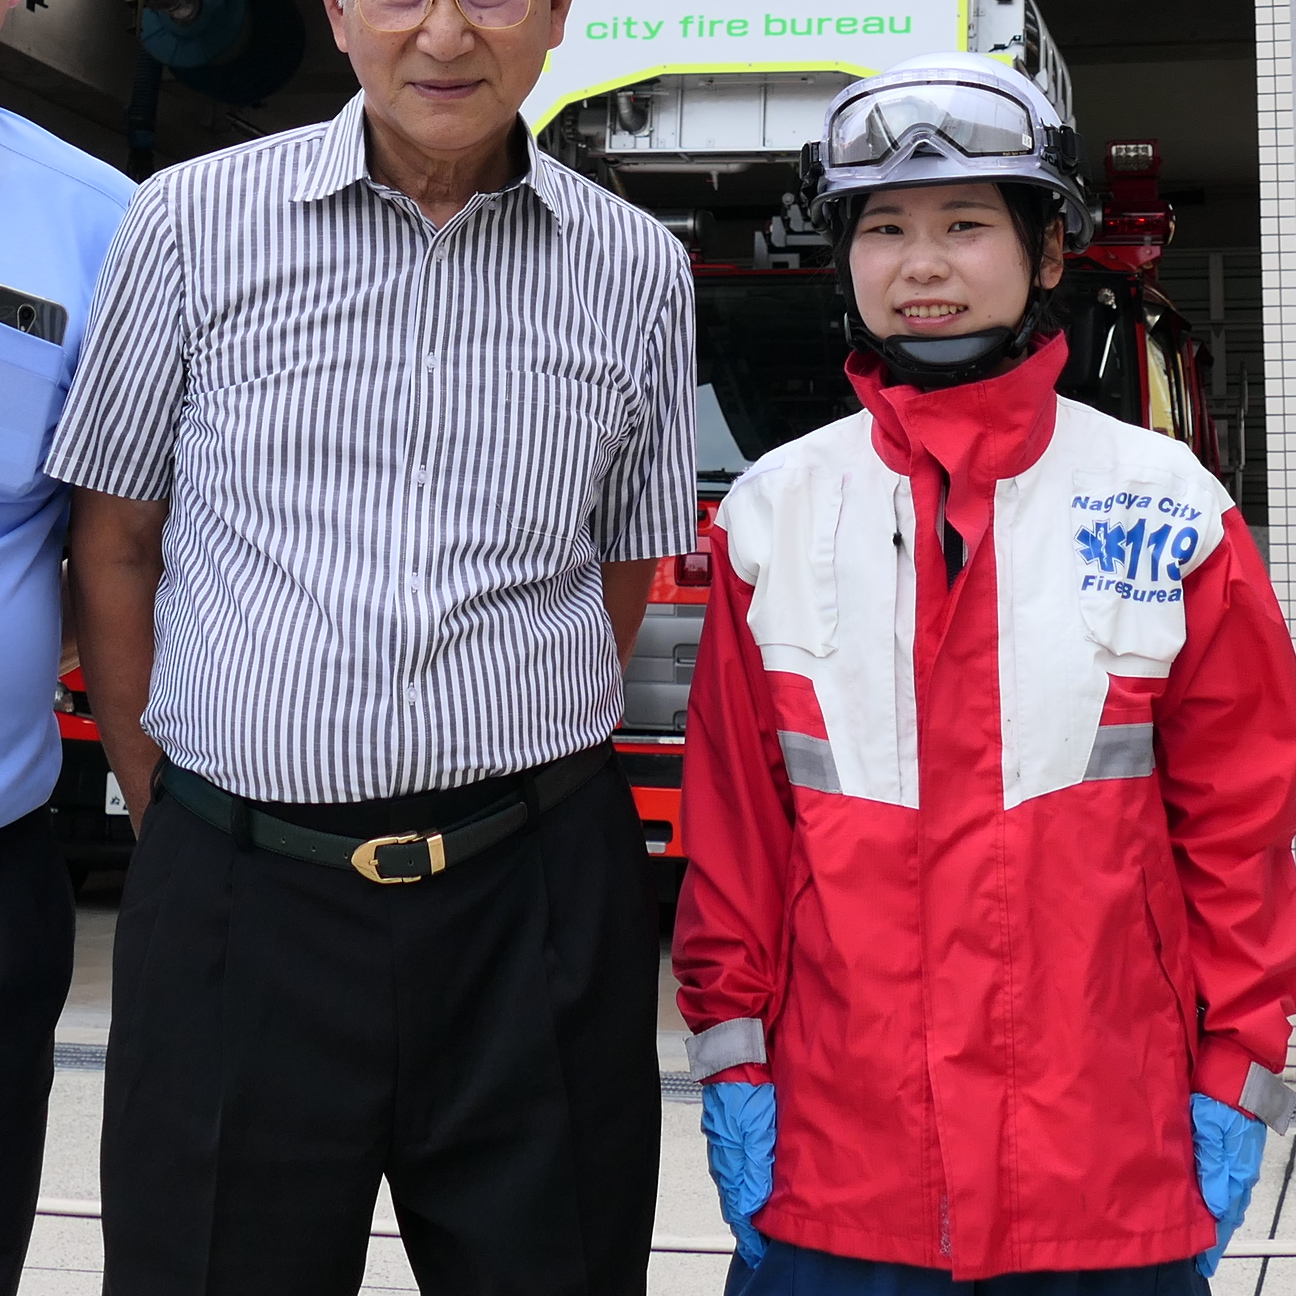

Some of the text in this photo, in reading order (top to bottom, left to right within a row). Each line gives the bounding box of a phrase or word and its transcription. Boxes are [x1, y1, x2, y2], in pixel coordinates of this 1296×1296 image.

[586, 14, 912, 40] city fire bureau
[1071, 492, 1202, 521] Nagoya City
[1126, 518, 1199, 581] 119
[1081, 575, 1183, 603] Fire Burea
